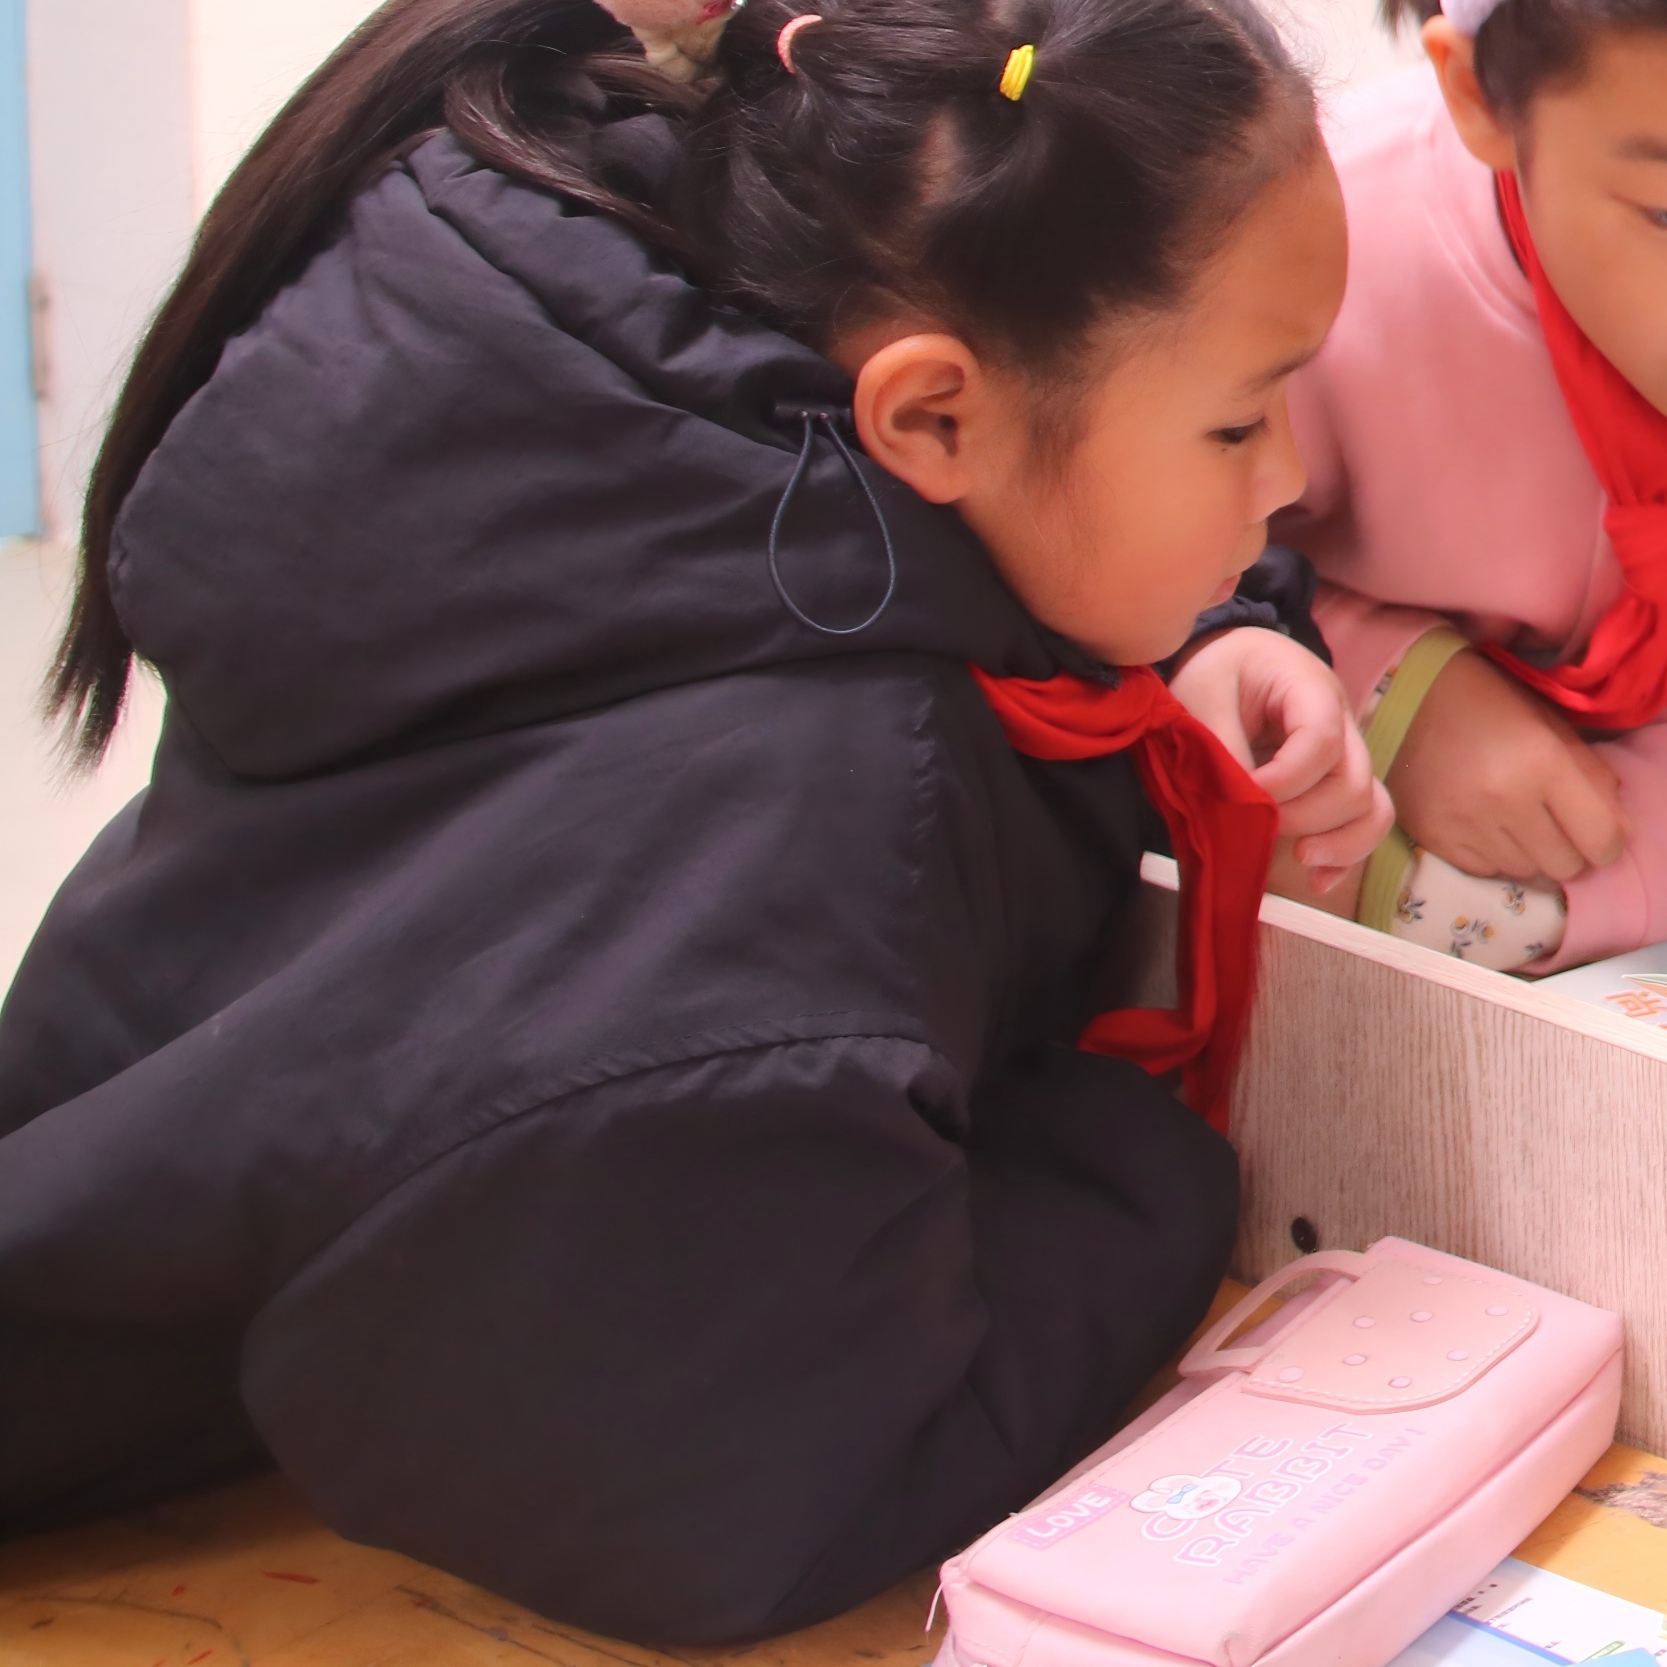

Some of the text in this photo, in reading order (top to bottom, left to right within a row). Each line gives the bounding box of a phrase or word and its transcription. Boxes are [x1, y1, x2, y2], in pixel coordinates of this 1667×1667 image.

[1026, 1490, 1113, 1539] LOVE
[1141, 1434, 1293, 1542] CTE
[1173, 1421, 1372, 1567] RABBIT
[1223, 1532, 1296, 1585] HAVE
[1293, 1516, 1316, 1531] A
[1309, 1472, 1370, 1515] NICE
